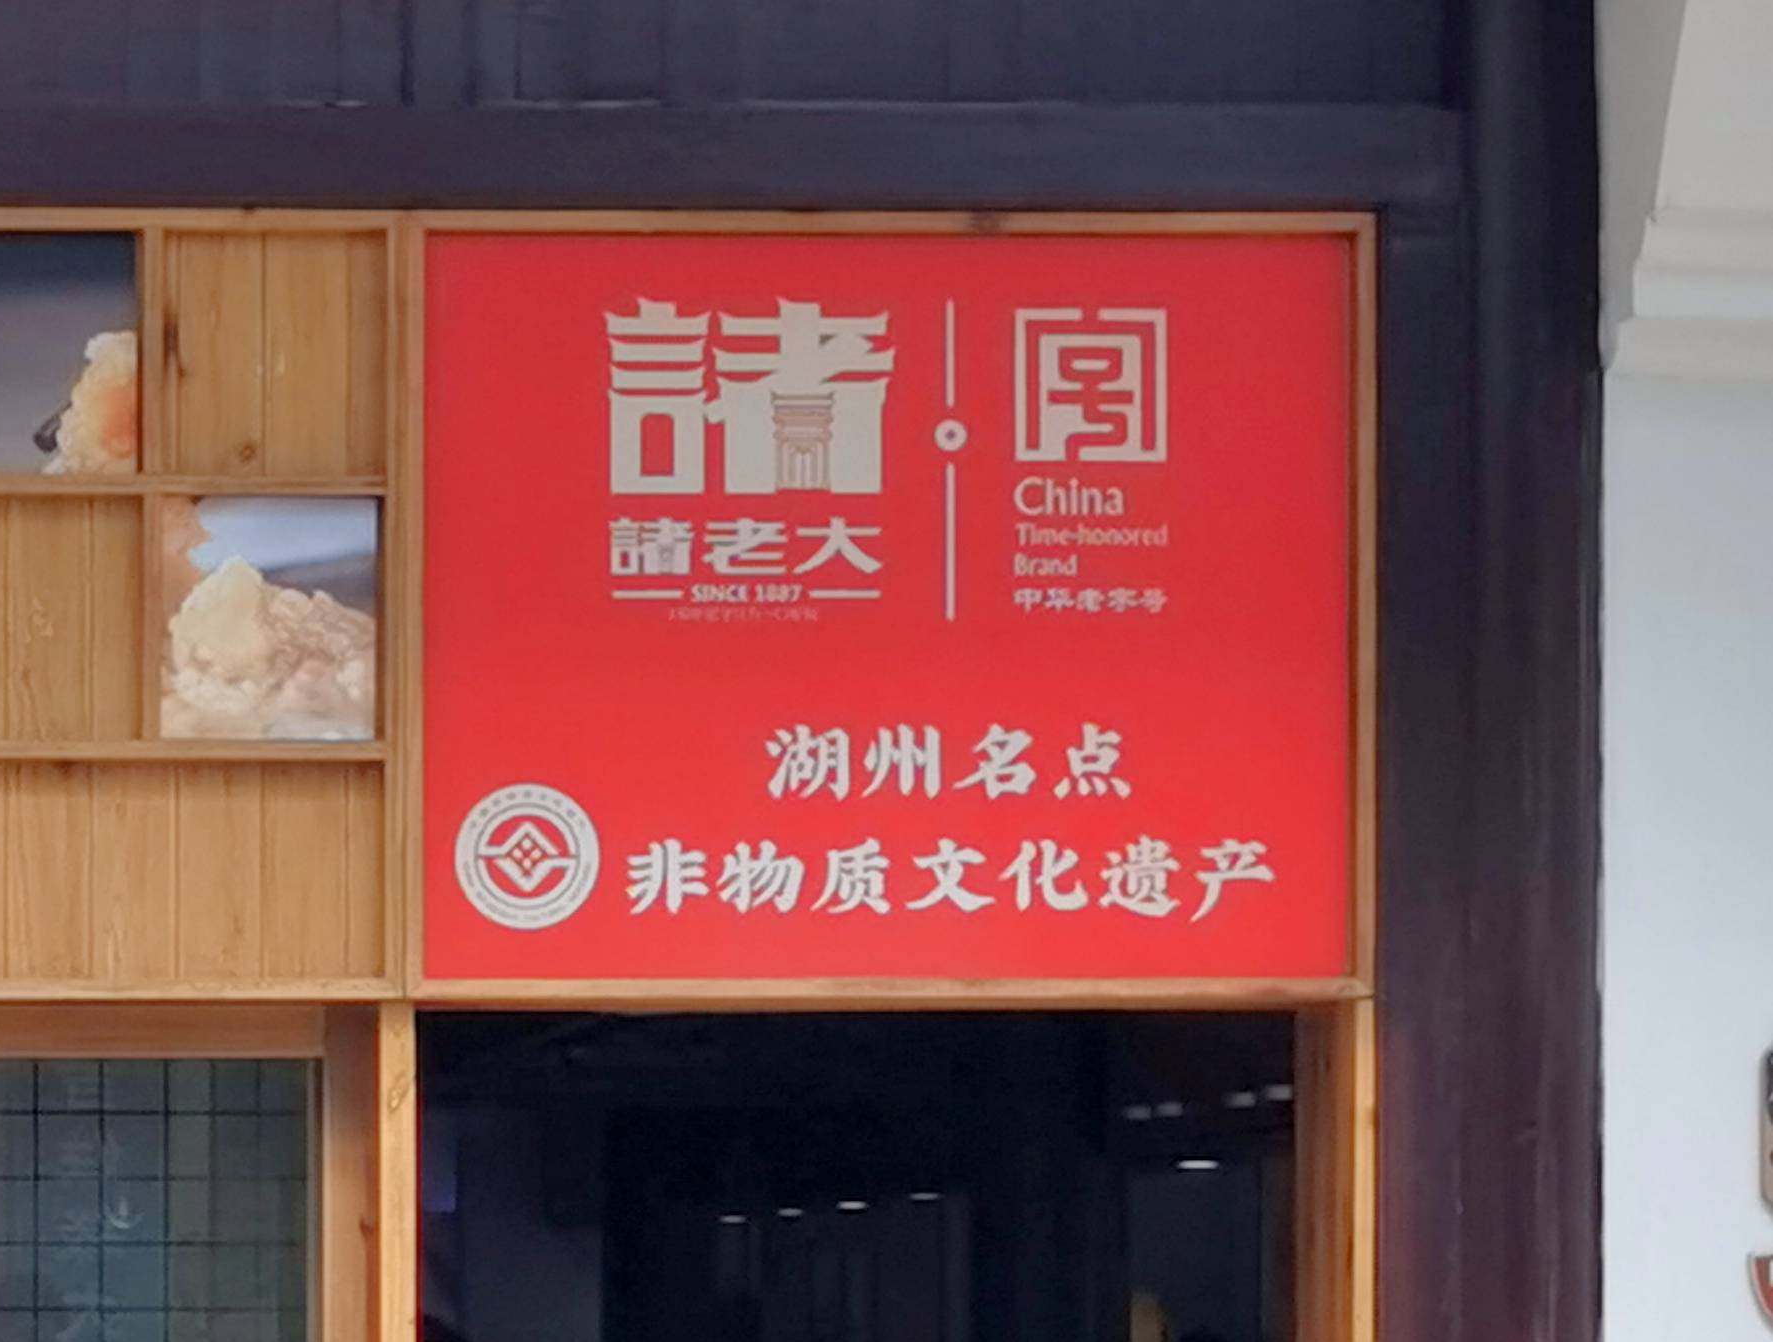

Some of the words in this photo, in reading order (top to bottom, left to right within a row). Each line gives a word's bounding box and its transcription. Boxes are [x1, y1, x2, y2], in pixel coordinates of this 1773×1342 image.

[1013, 476, 1125, 516] China
[1014, 522, 1169, 547] Time-honored
[1013, 552, 1078, 576] Brand
[690, 583, 748, 603] SINCE
[754, 583, 803, 603] 1887
[765, 722, 1133, 801] 湖州名点
[627, 834, 1277, 924] 非物质文化遗产
